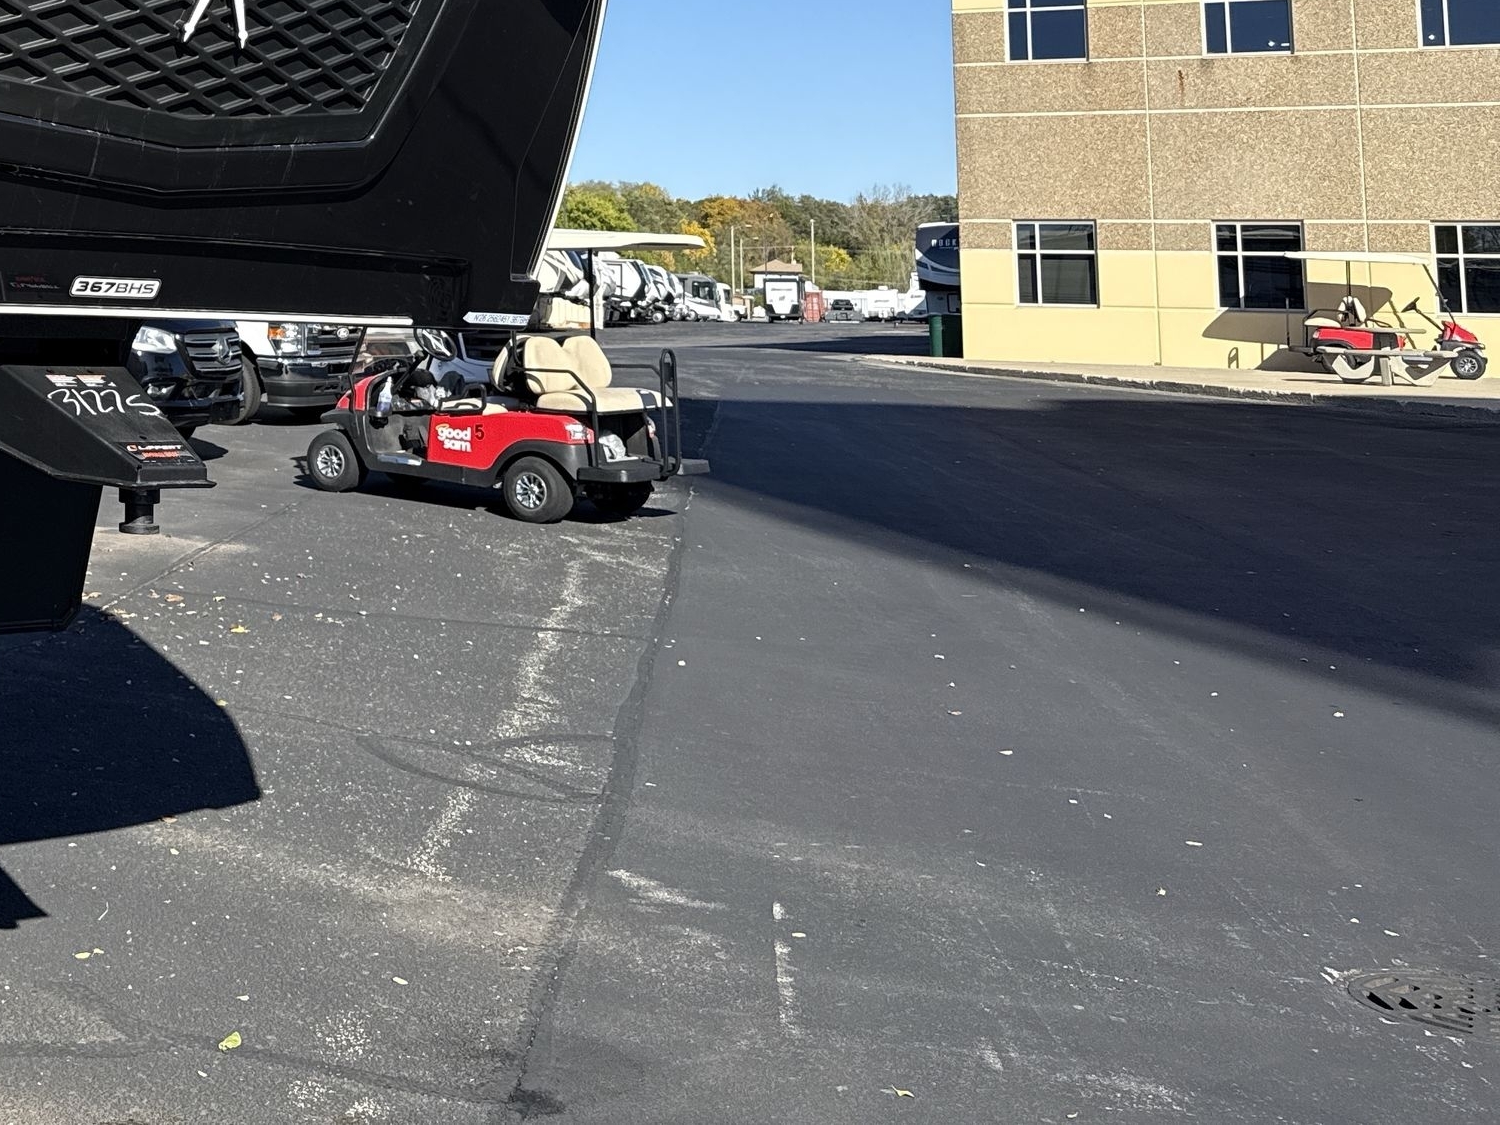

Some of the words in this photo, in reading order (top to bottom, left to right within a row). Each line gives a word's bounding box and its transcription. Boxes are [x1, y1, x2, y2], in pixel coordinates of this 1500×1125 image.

[75, 280, 157, 295] 367BHS
[436, 426, 472, 442] good
[474, 423, 485, 441] 5
[443, 439, 472, 452] sam
